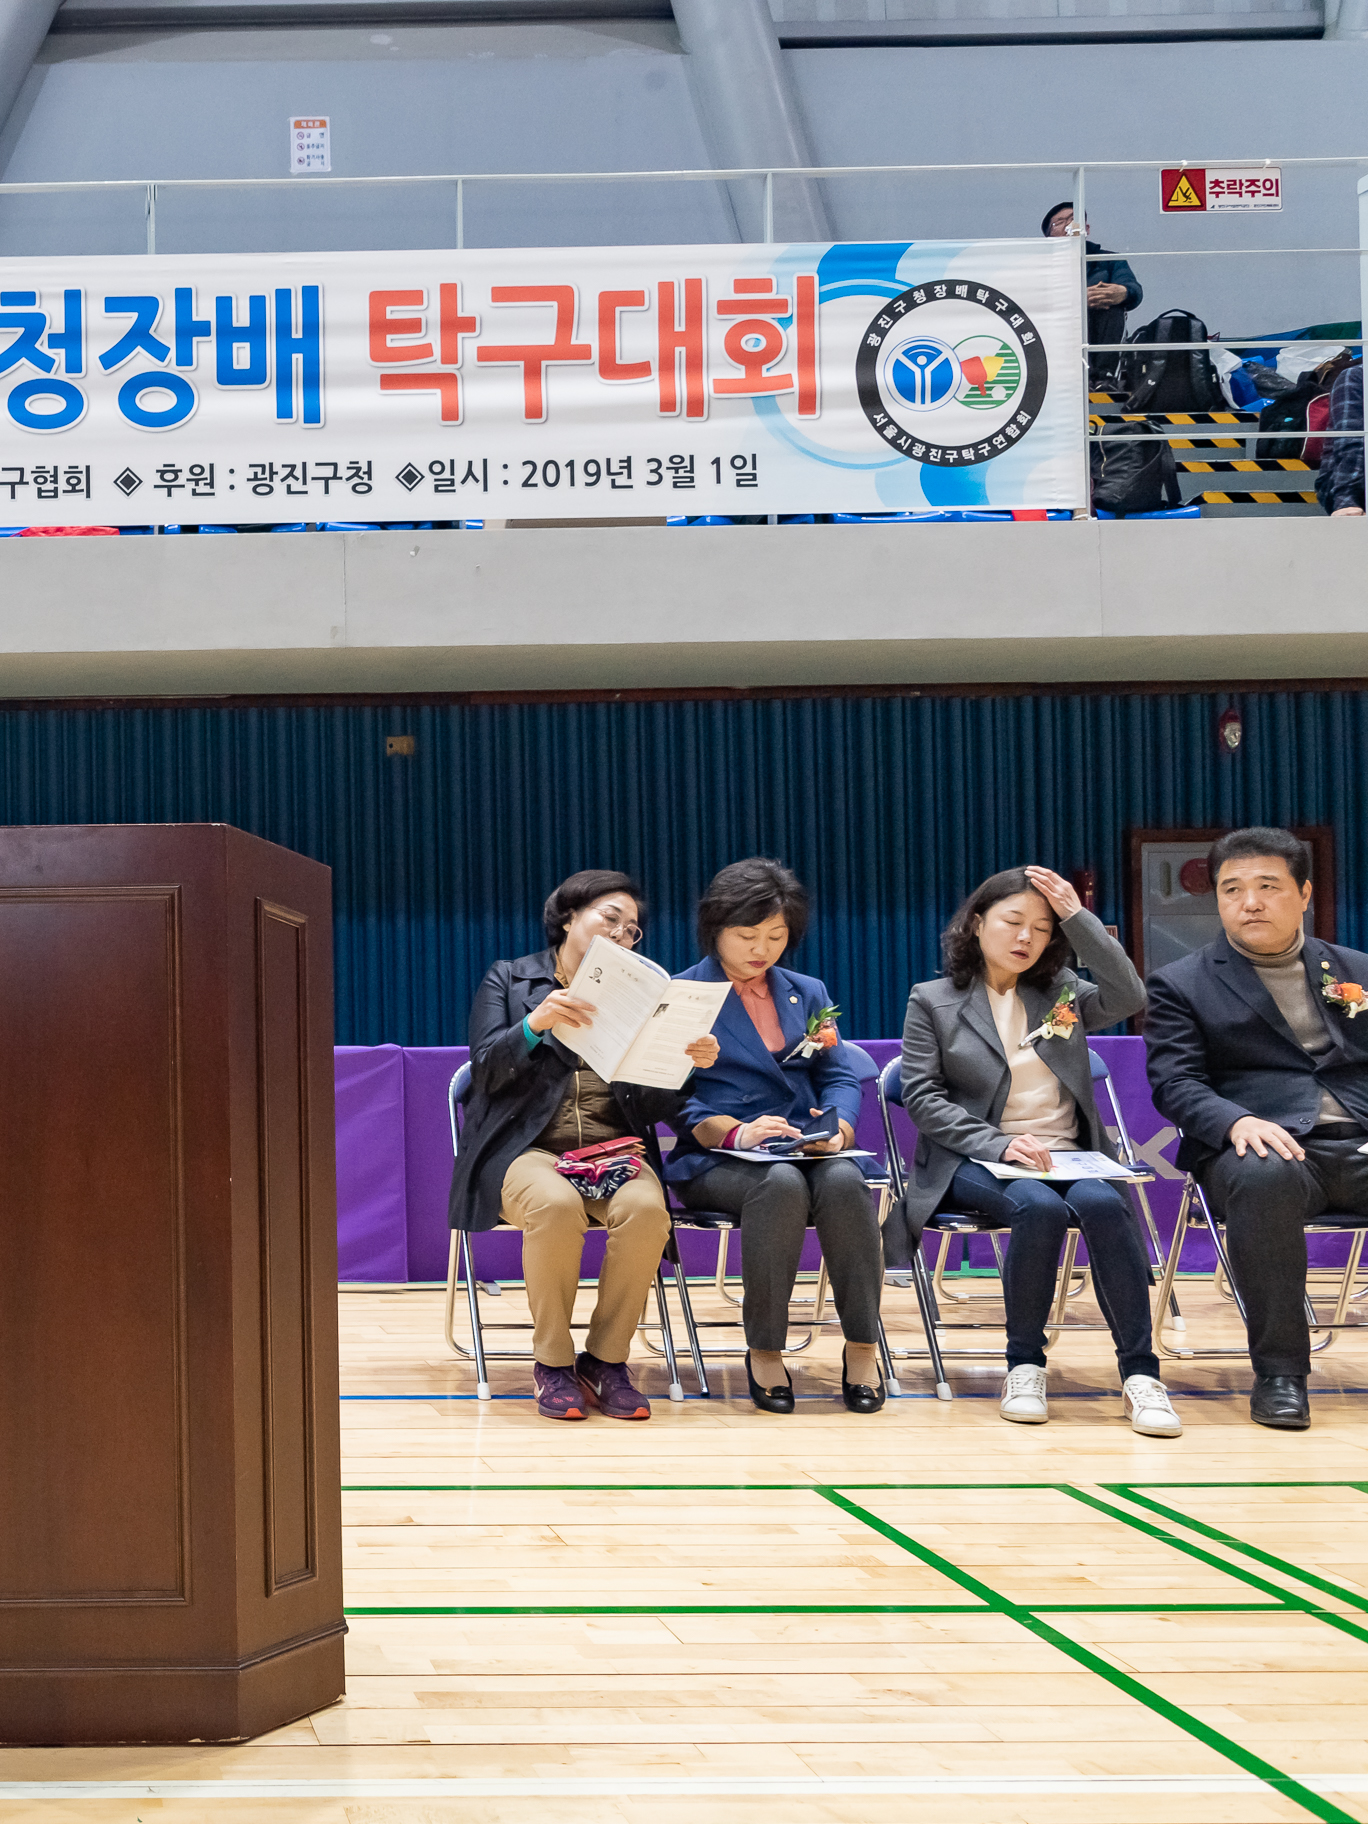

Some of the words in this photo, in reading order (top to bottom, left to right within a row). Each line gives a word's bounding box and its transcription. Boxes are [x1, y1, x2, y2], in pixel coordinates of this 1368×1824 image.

[1208, 178, 1280, 198] 추락주의
[368, 275, 817, 422] 탁구대회
[153, 463, 216, 498] 후원
[246, 460, 373, 496] 광진구청
[521, 455, 635, 490] 2019년
[646, 454, 697, 489] 3월
[710, 453, 760, 488] 1일
